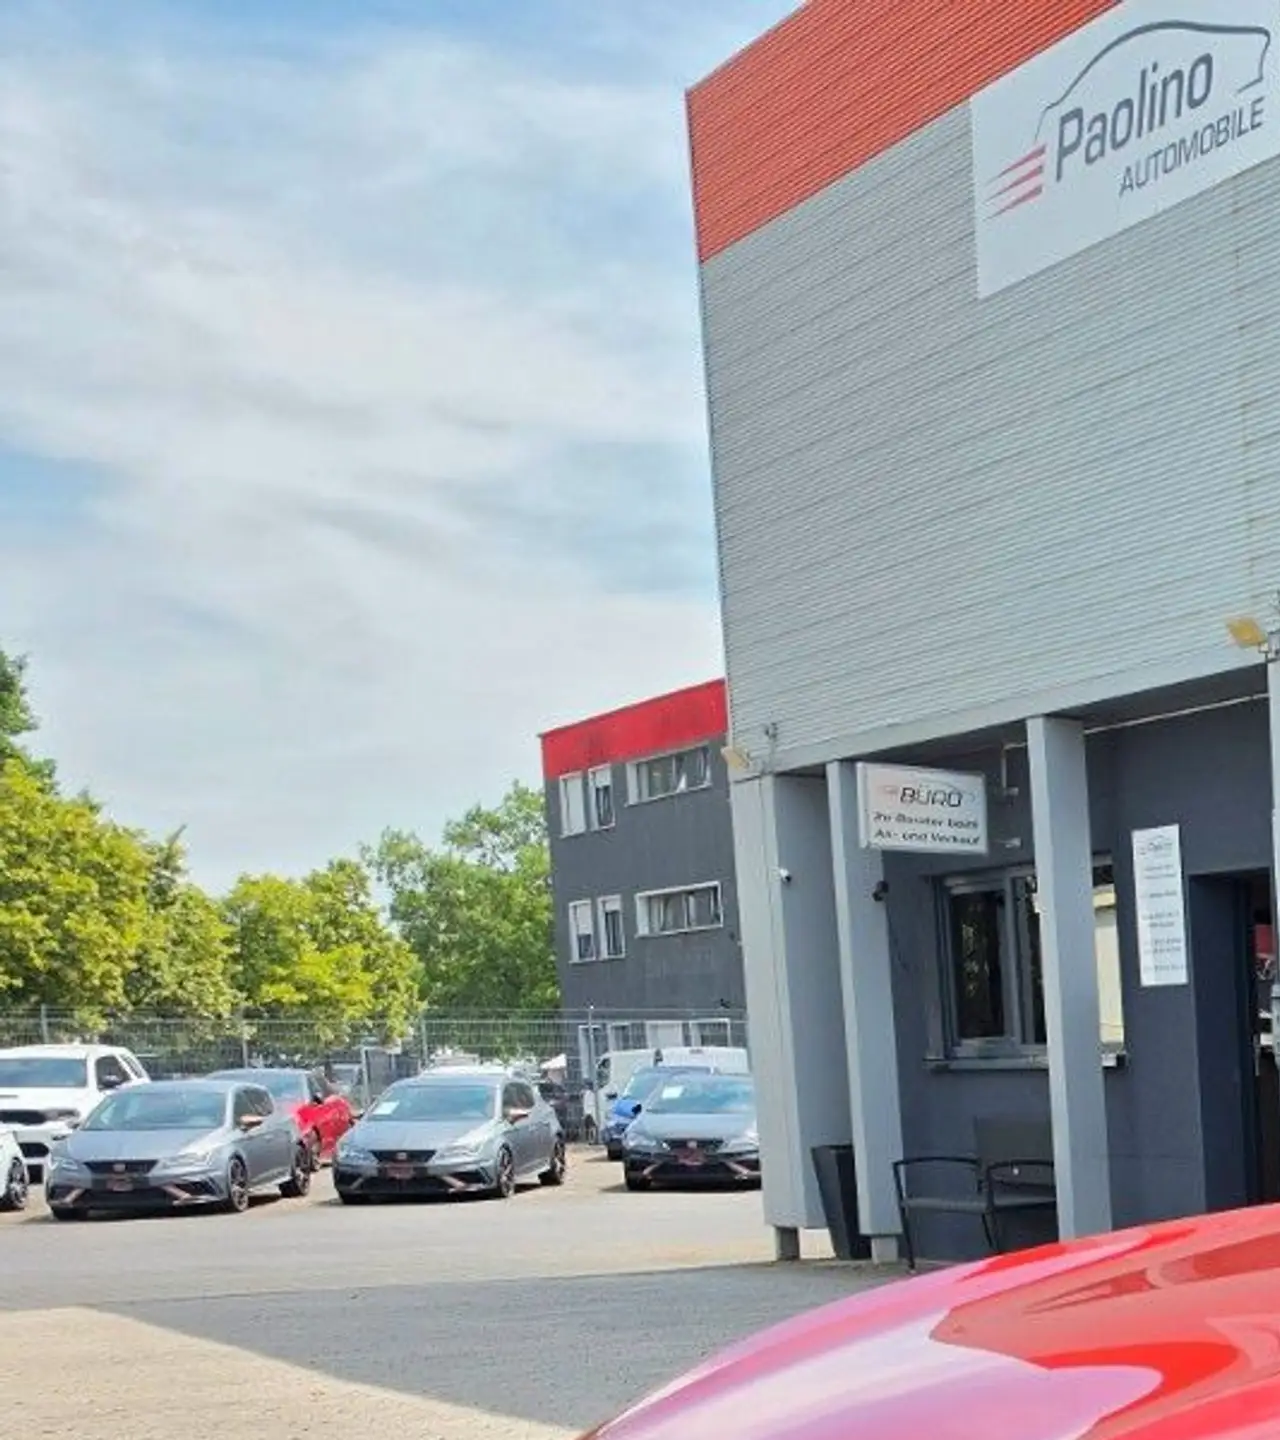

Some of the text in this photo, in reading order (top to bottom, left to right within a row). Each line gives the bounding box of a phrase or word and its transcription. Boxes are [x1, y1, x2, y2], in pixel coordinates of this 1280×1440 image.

[1055, 52, 1214, 183] Paolino
[1118, 96, 1265, 198] AUTOMOBILE
[900, 783, 963, 808] BÜRO
